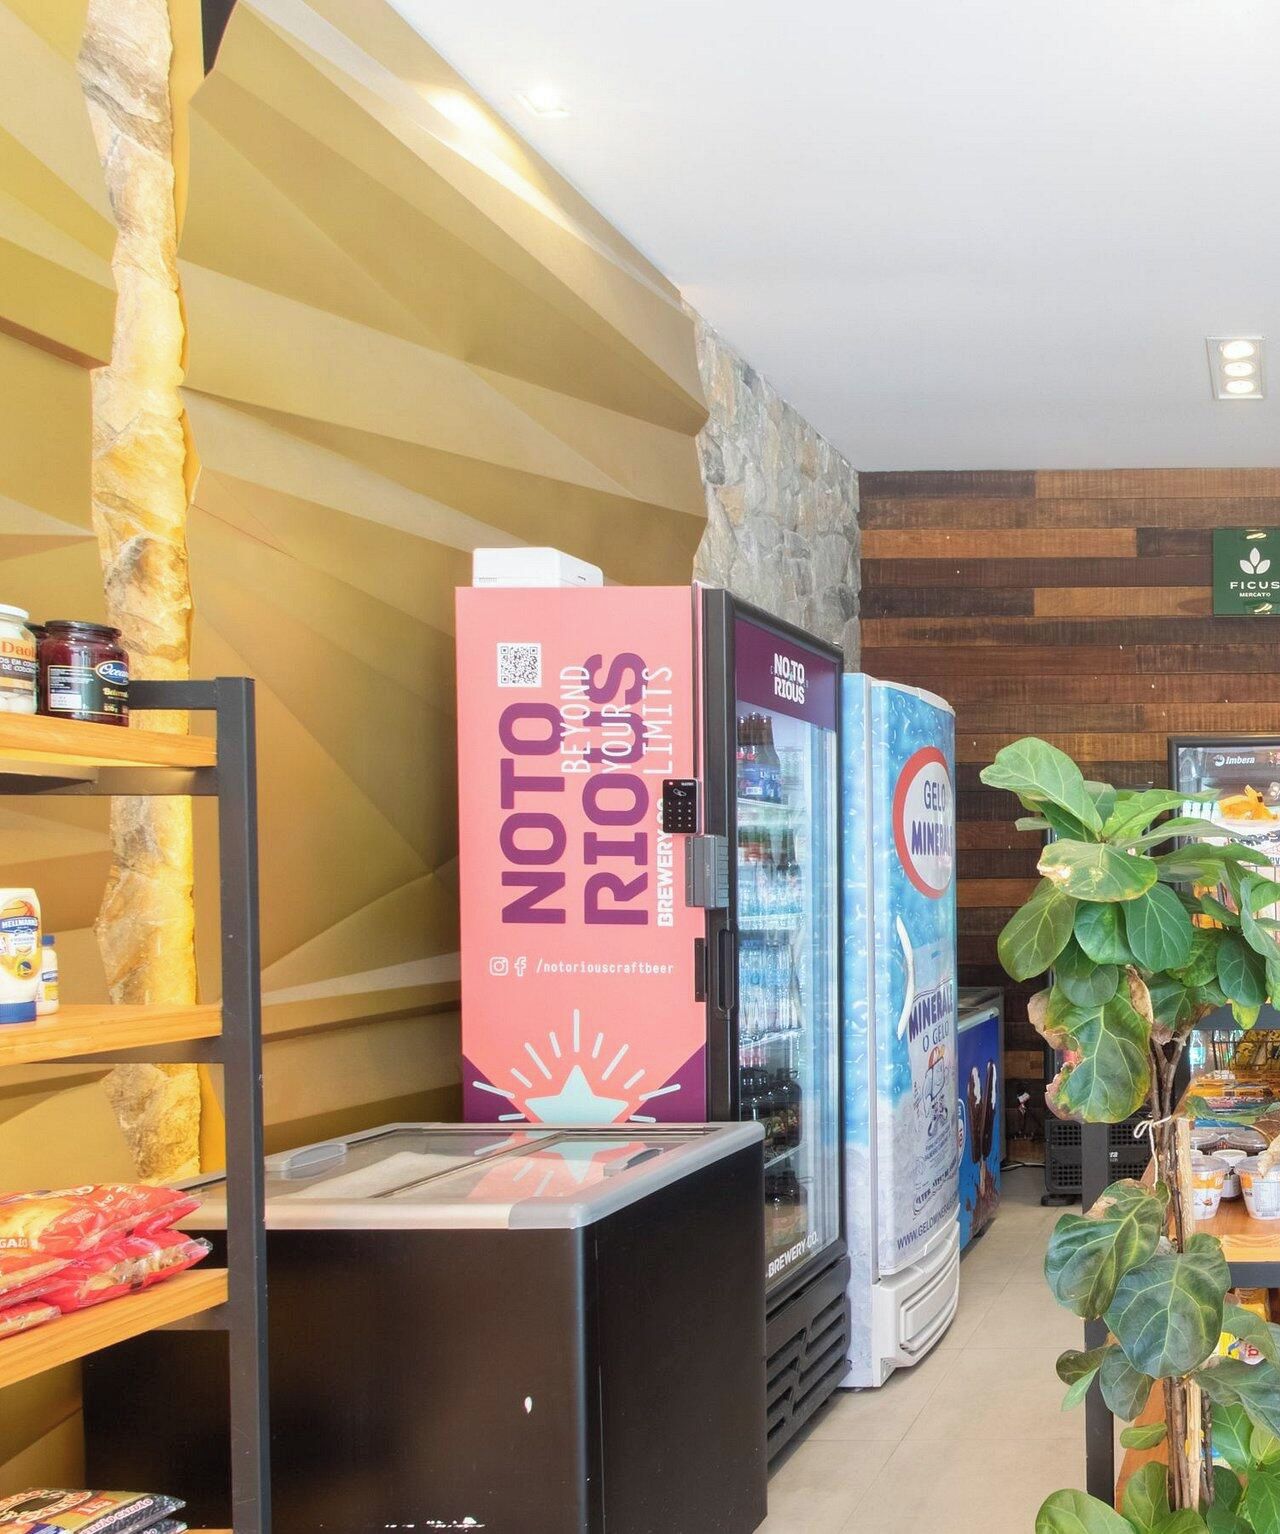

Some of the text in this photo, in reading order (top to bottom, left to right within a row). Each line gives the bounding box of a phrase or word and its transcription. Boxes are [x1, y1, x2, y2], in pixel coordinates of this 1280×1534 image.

[1230, 581, 1280, 590] FICUS
[774, 676, 805, 704] RIOUS
[559, 665, 592, 774] BEYOND
[601, 702, 633, 774] YOUR
[642, 665, 673, 775] LIMITS
[581, 652, 650, 925] RIOUS
[1225, 756, 1255, 766] Imbera
[499, 702, 570, 924] NOTO
[923, 780, 946, 812] GELO
[656, 829, 674, 928] BREWERY
[535, 960, 675, 976] /notoriouscraftbeer
[768, 1238, 806, 1279] BREWERY
